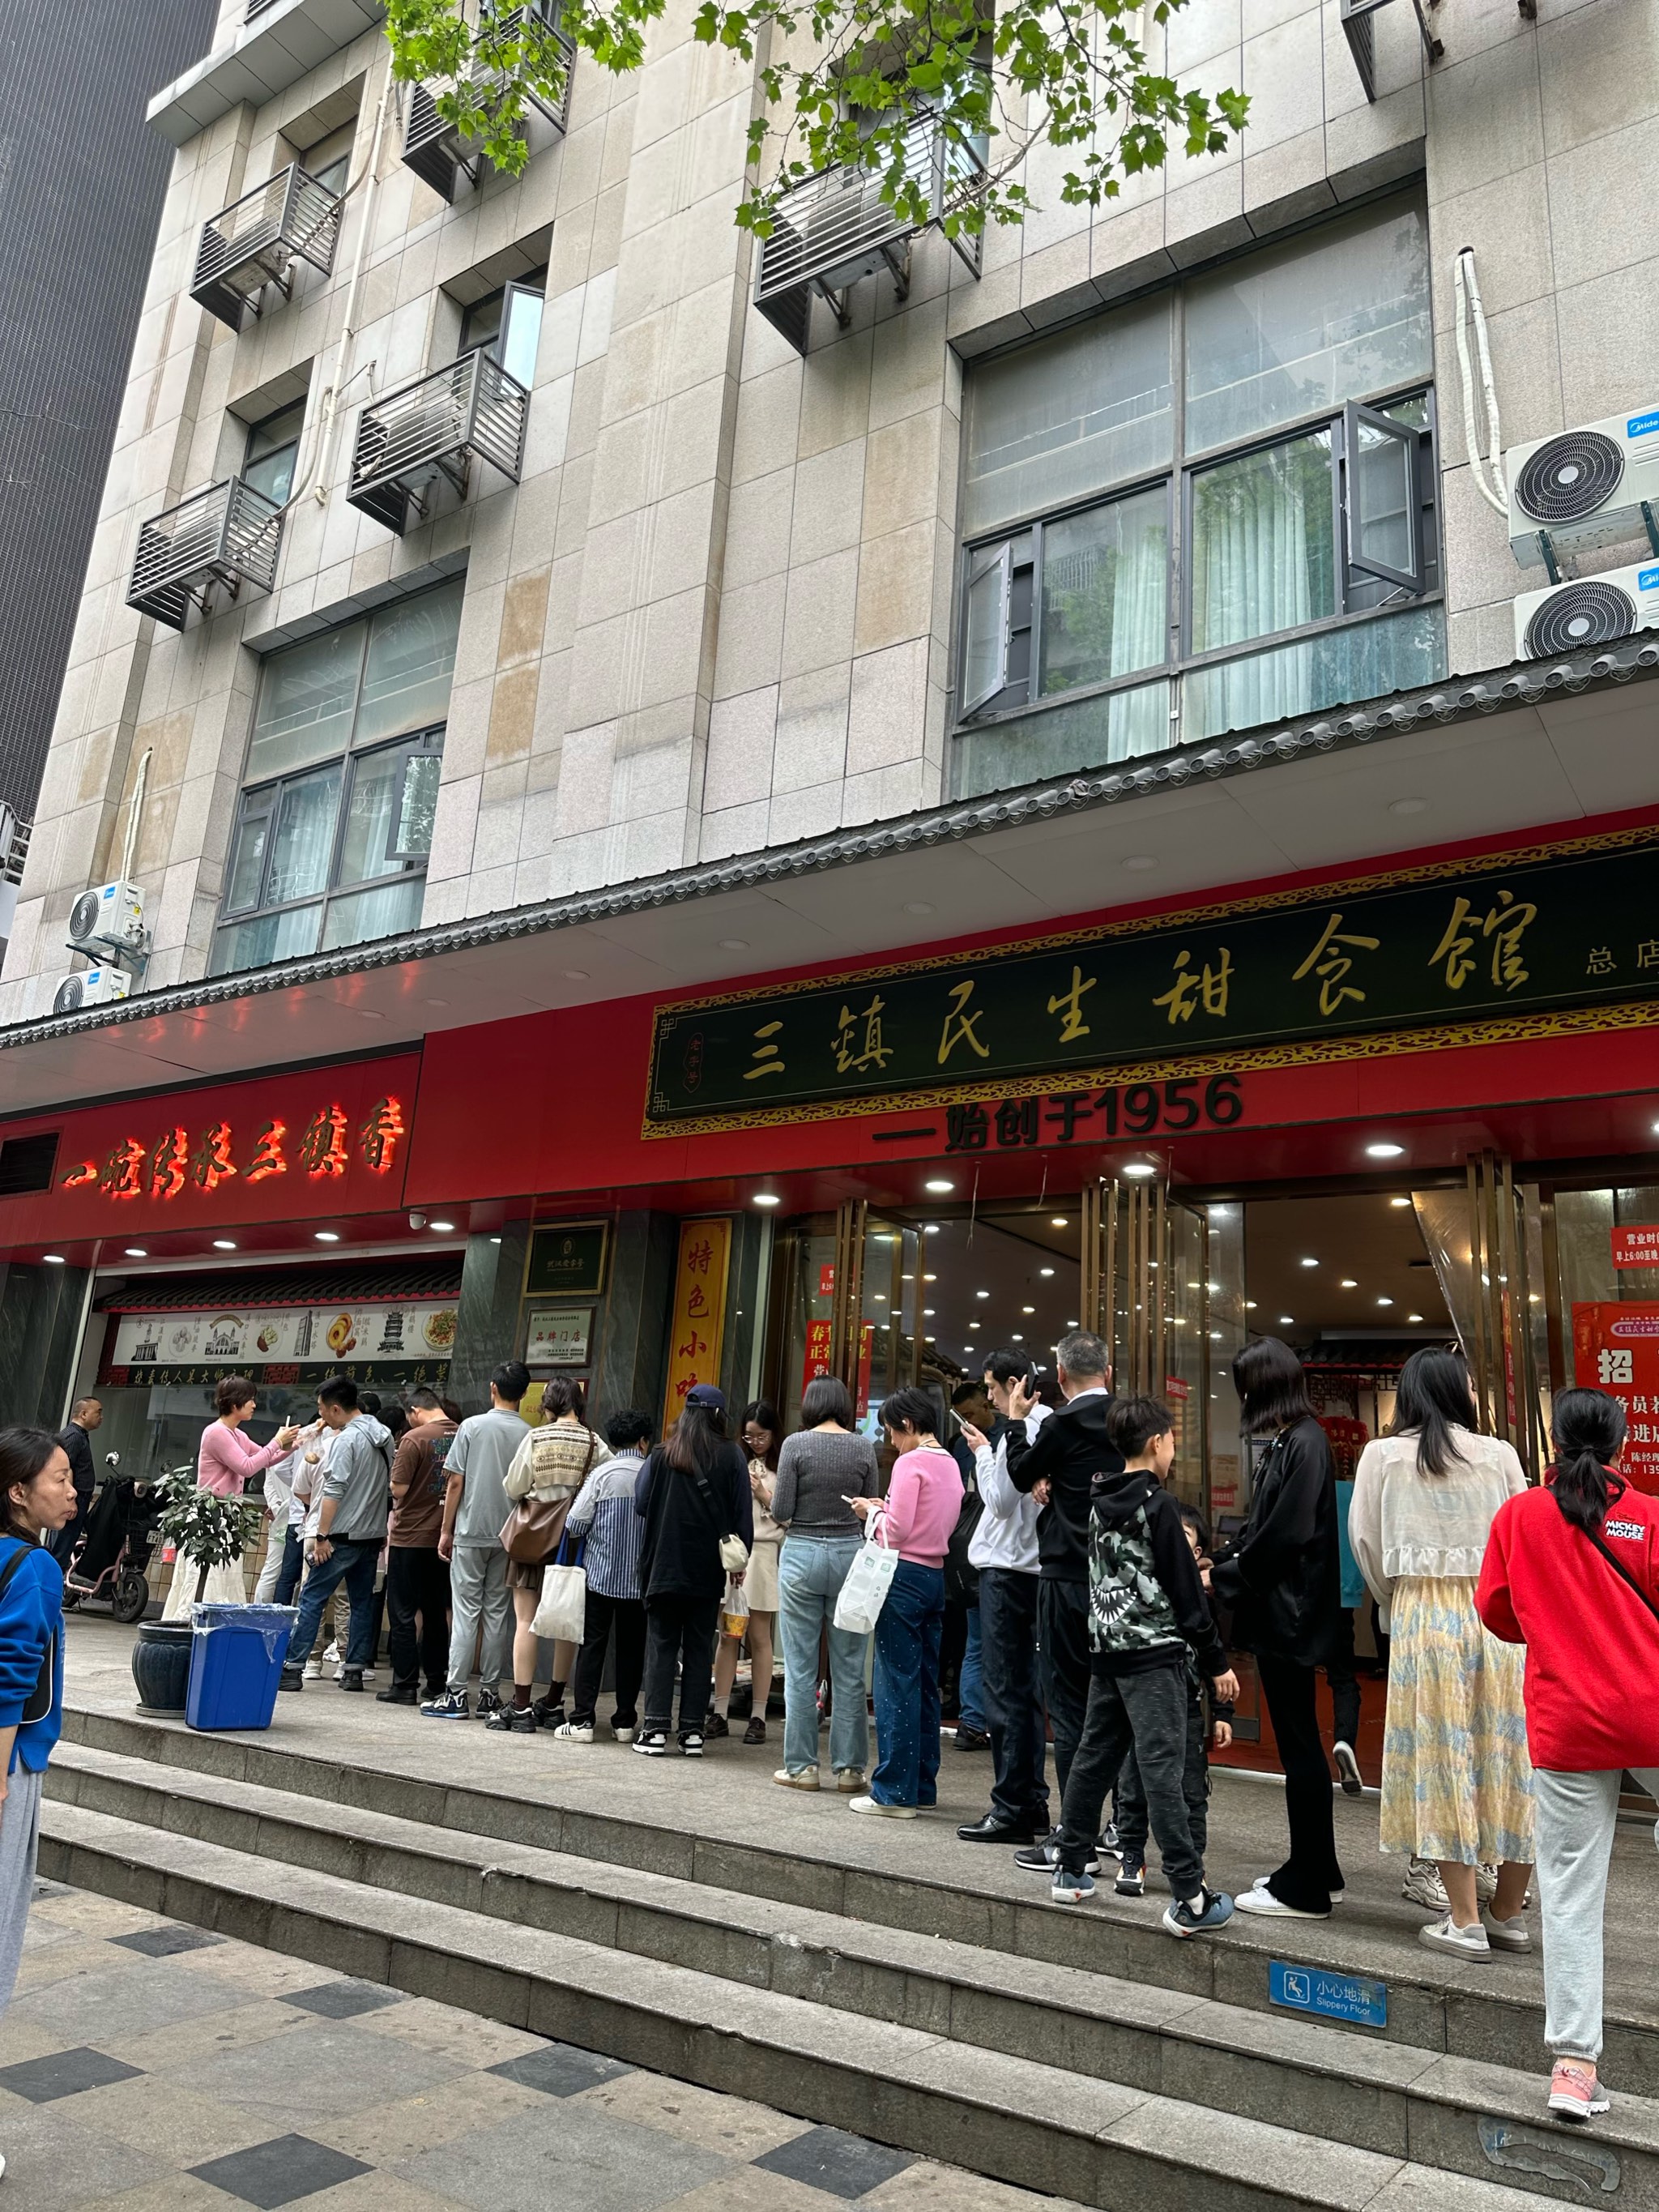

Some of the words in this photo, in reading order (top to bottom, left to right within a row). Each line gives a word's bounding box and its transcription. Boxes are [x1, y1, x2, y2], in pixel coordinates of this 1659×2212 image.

[1626, 1232, 1659, 1245] 营业时
[535, 1330, 581, 1343] 品牌门店
[1606, 1520, 1646, 1532] MICKEY
[1606, 1528, 1644, 1541] MOUSE
[1316, 1980, 1371, 2005] 小心地滑
[1316, 1996, 1348, 2012] Slippery
[1350, 2004, 1371, 2016] Floor
